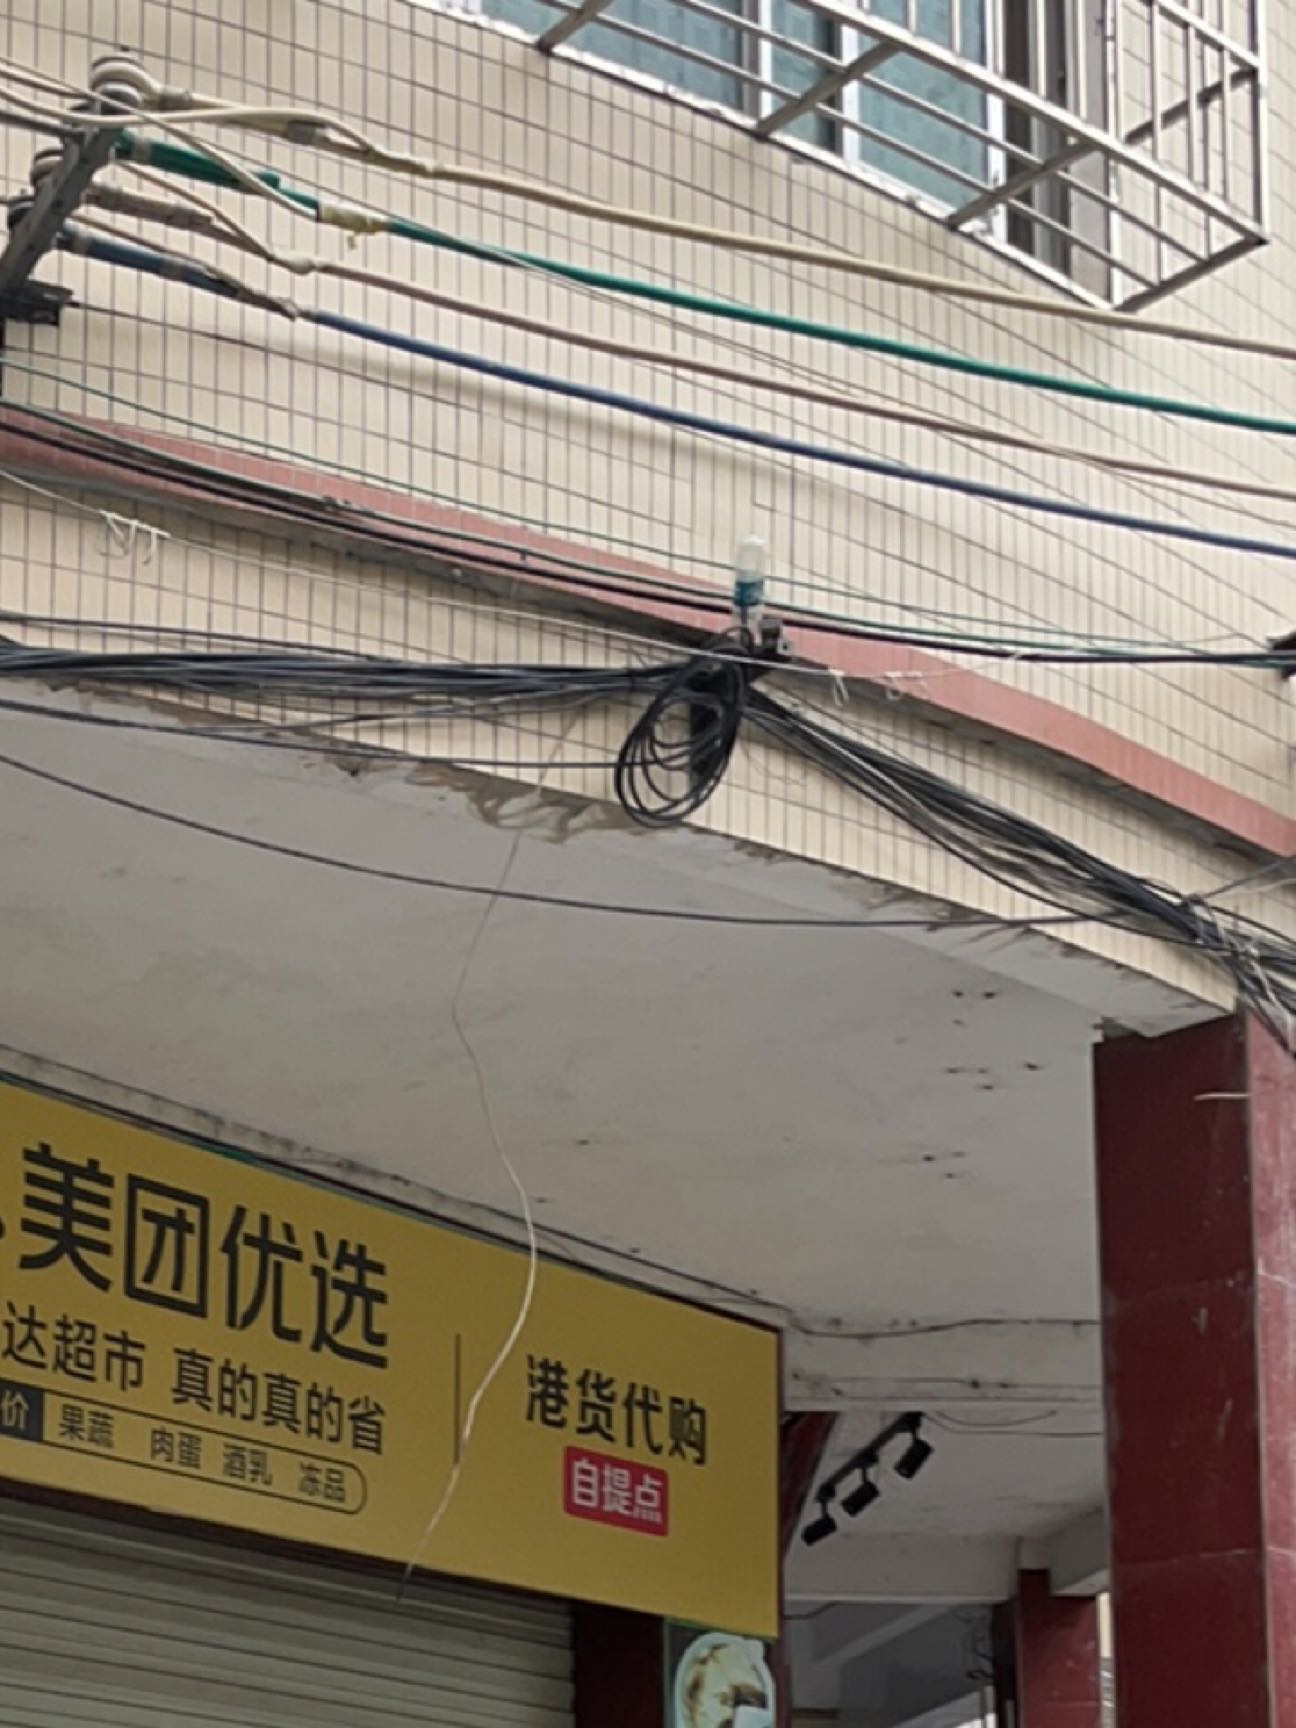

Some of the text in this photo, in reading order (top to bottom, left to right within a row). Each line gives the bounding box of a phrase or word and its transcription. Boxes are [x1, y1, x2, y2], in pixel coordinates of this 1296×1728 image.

[18, 1142, 389, 1369] 美团优选
[58, 1403, 115, 1450] 果蔬
[149, 1426, 204, 1471] 肉蛋
[170, 1347, 385, 1456] 真的真的省
[525, 1353, 708, 1466] 港货代购
[571, 1457, 663, 1524] 自提点
